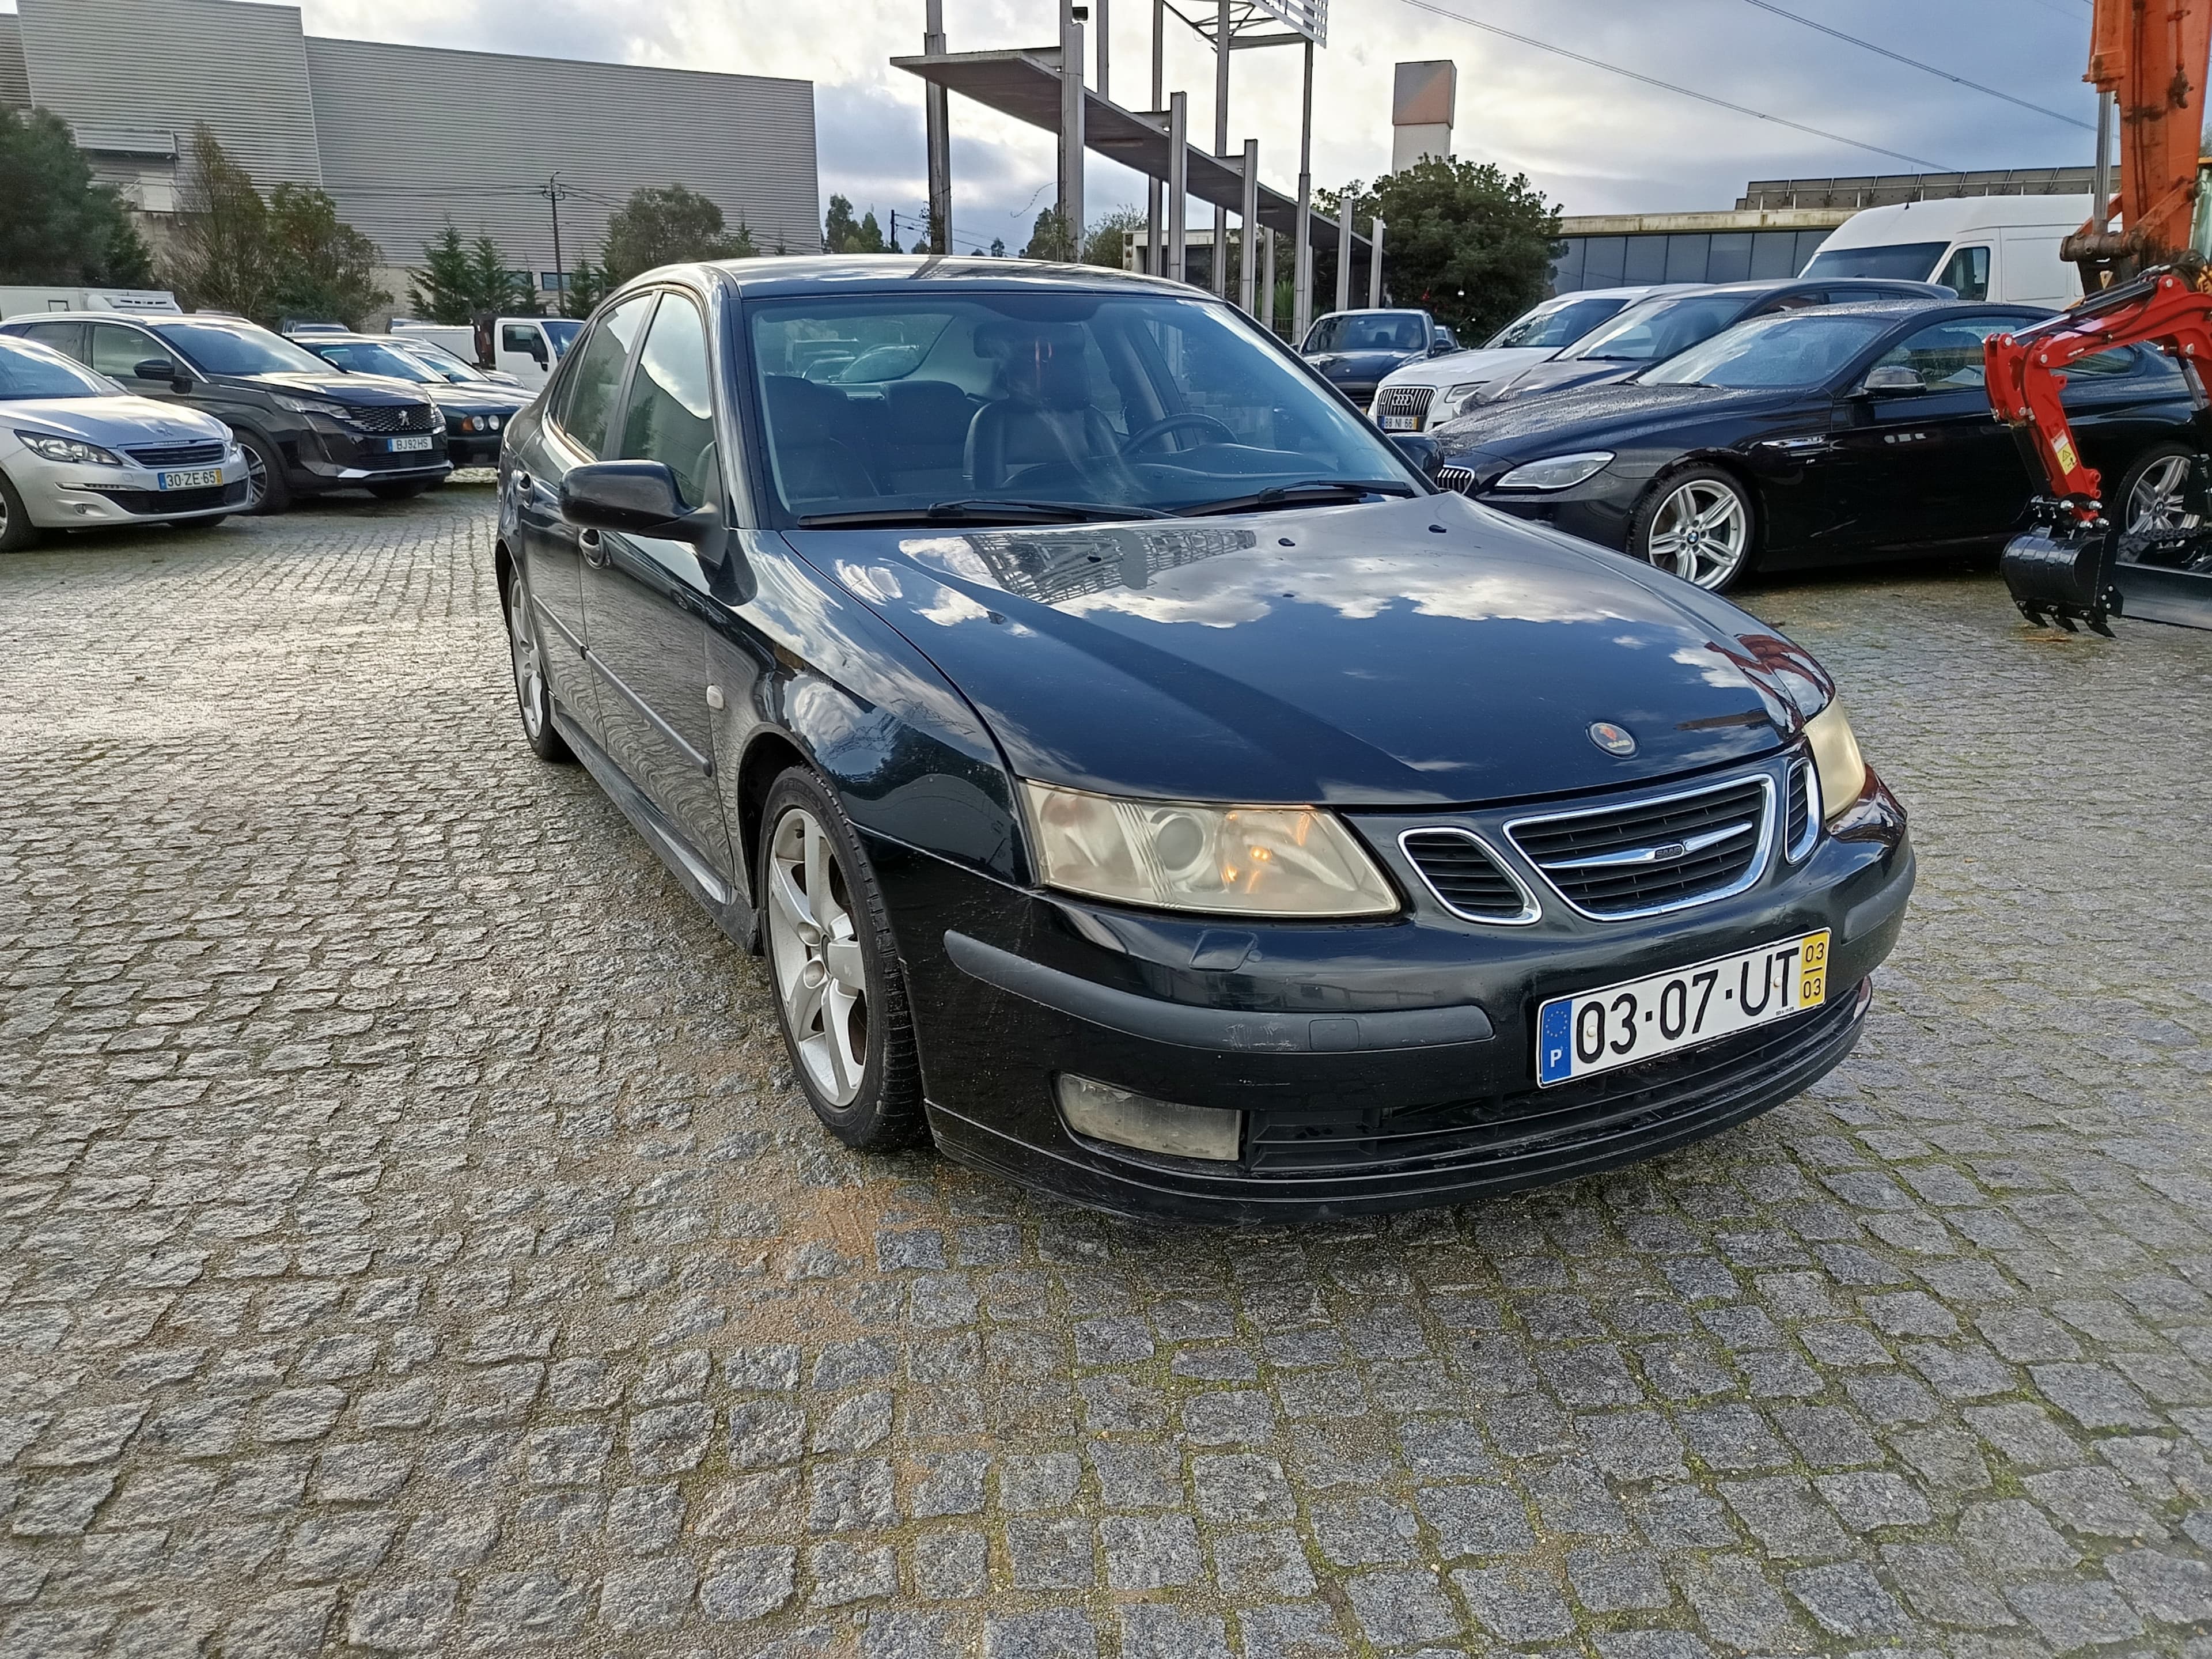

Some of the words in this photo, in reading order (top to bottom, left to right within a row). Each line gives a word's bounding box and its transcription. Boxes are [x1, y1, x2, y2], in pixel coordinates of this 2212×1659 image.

[396, 438, 428, 450] BJ92HS
[1656, 847, 1681, 858] SAAB
[1805, 942, 1825, 963] 03
[1802, 978, 1821, 999] 03
[1550, 1048, 1562, 1067] P
